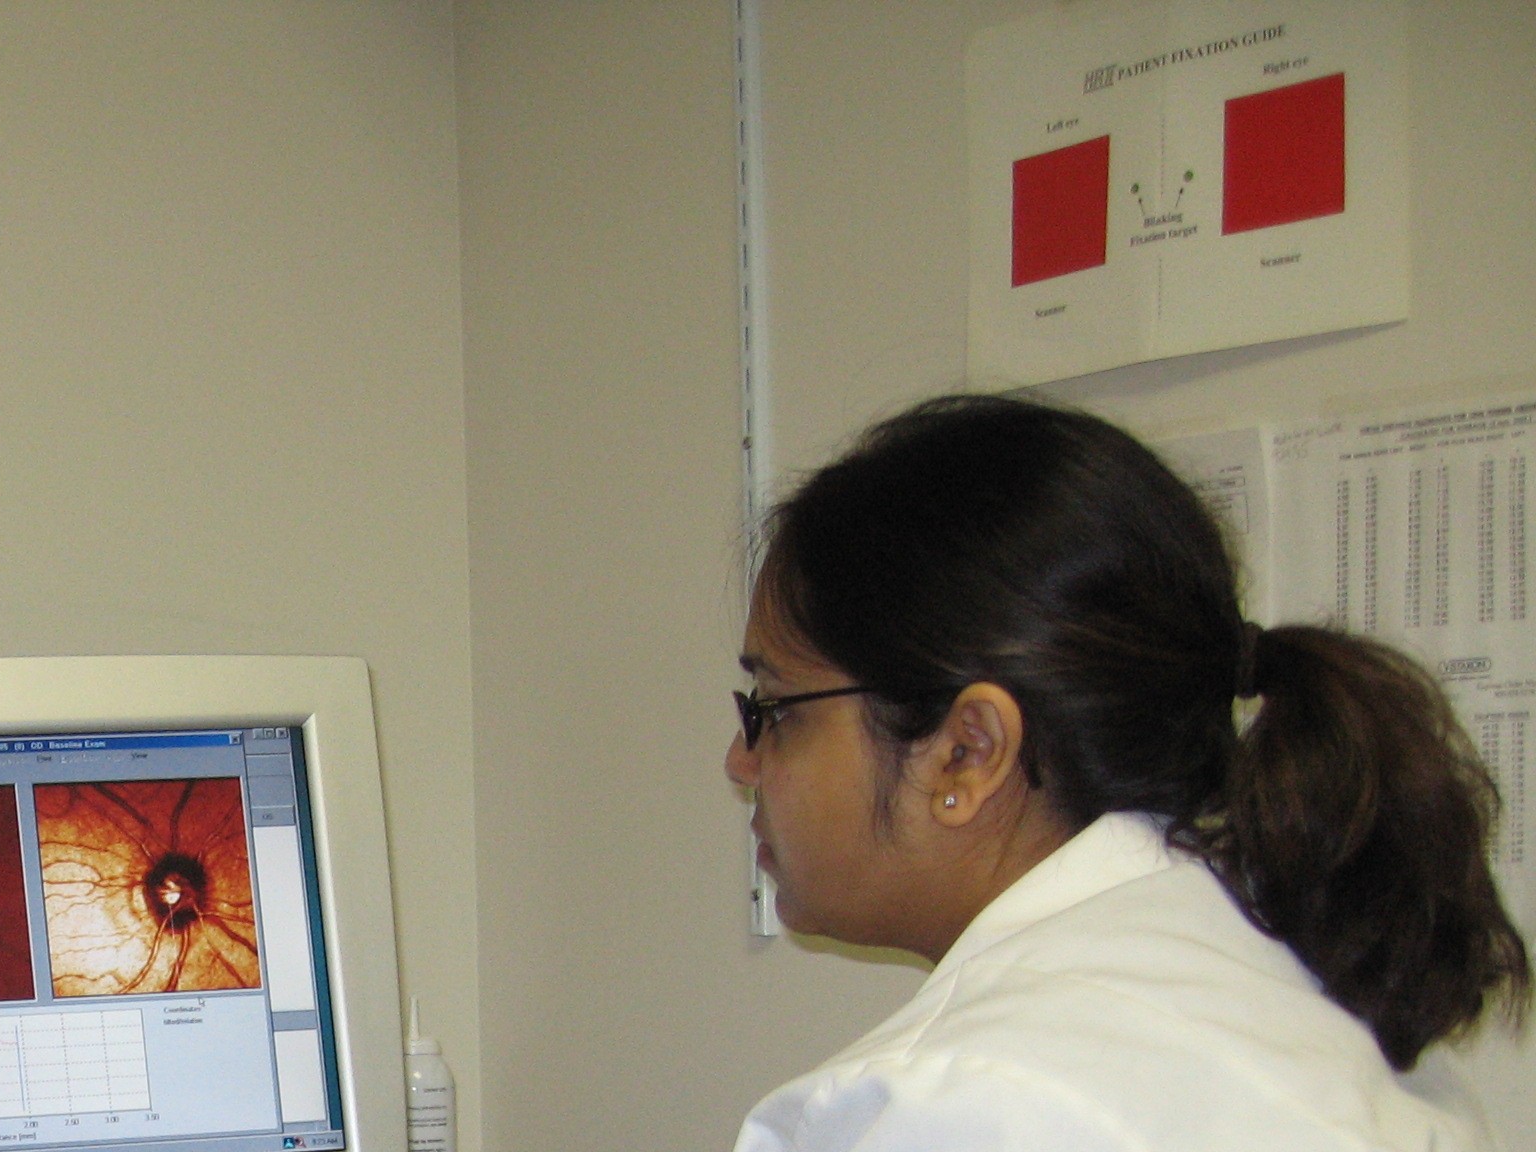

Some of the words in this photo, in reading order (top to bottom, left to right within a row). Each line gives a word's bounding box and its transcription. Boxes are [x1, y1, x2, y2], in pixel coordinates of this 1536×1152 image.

[1118, 56, 1166, 80] PATIENT
[1170, 39, 1239, 63] FIXATION
[1242, 25, 1286, 47] GUIDE
[1263, 59, 1290, 76] Right
[1292, 56, 1309, 69] eye
[1047, 121, 1064, 134] Left
[1168, 225, 1199, 240] target
[1259, 251, 1302, 269] Scanner
[1035, 304, 1067, 318] Scanner
[49, 741, 83, 750] Baseline
[84, 740, 106, 749] Exam
